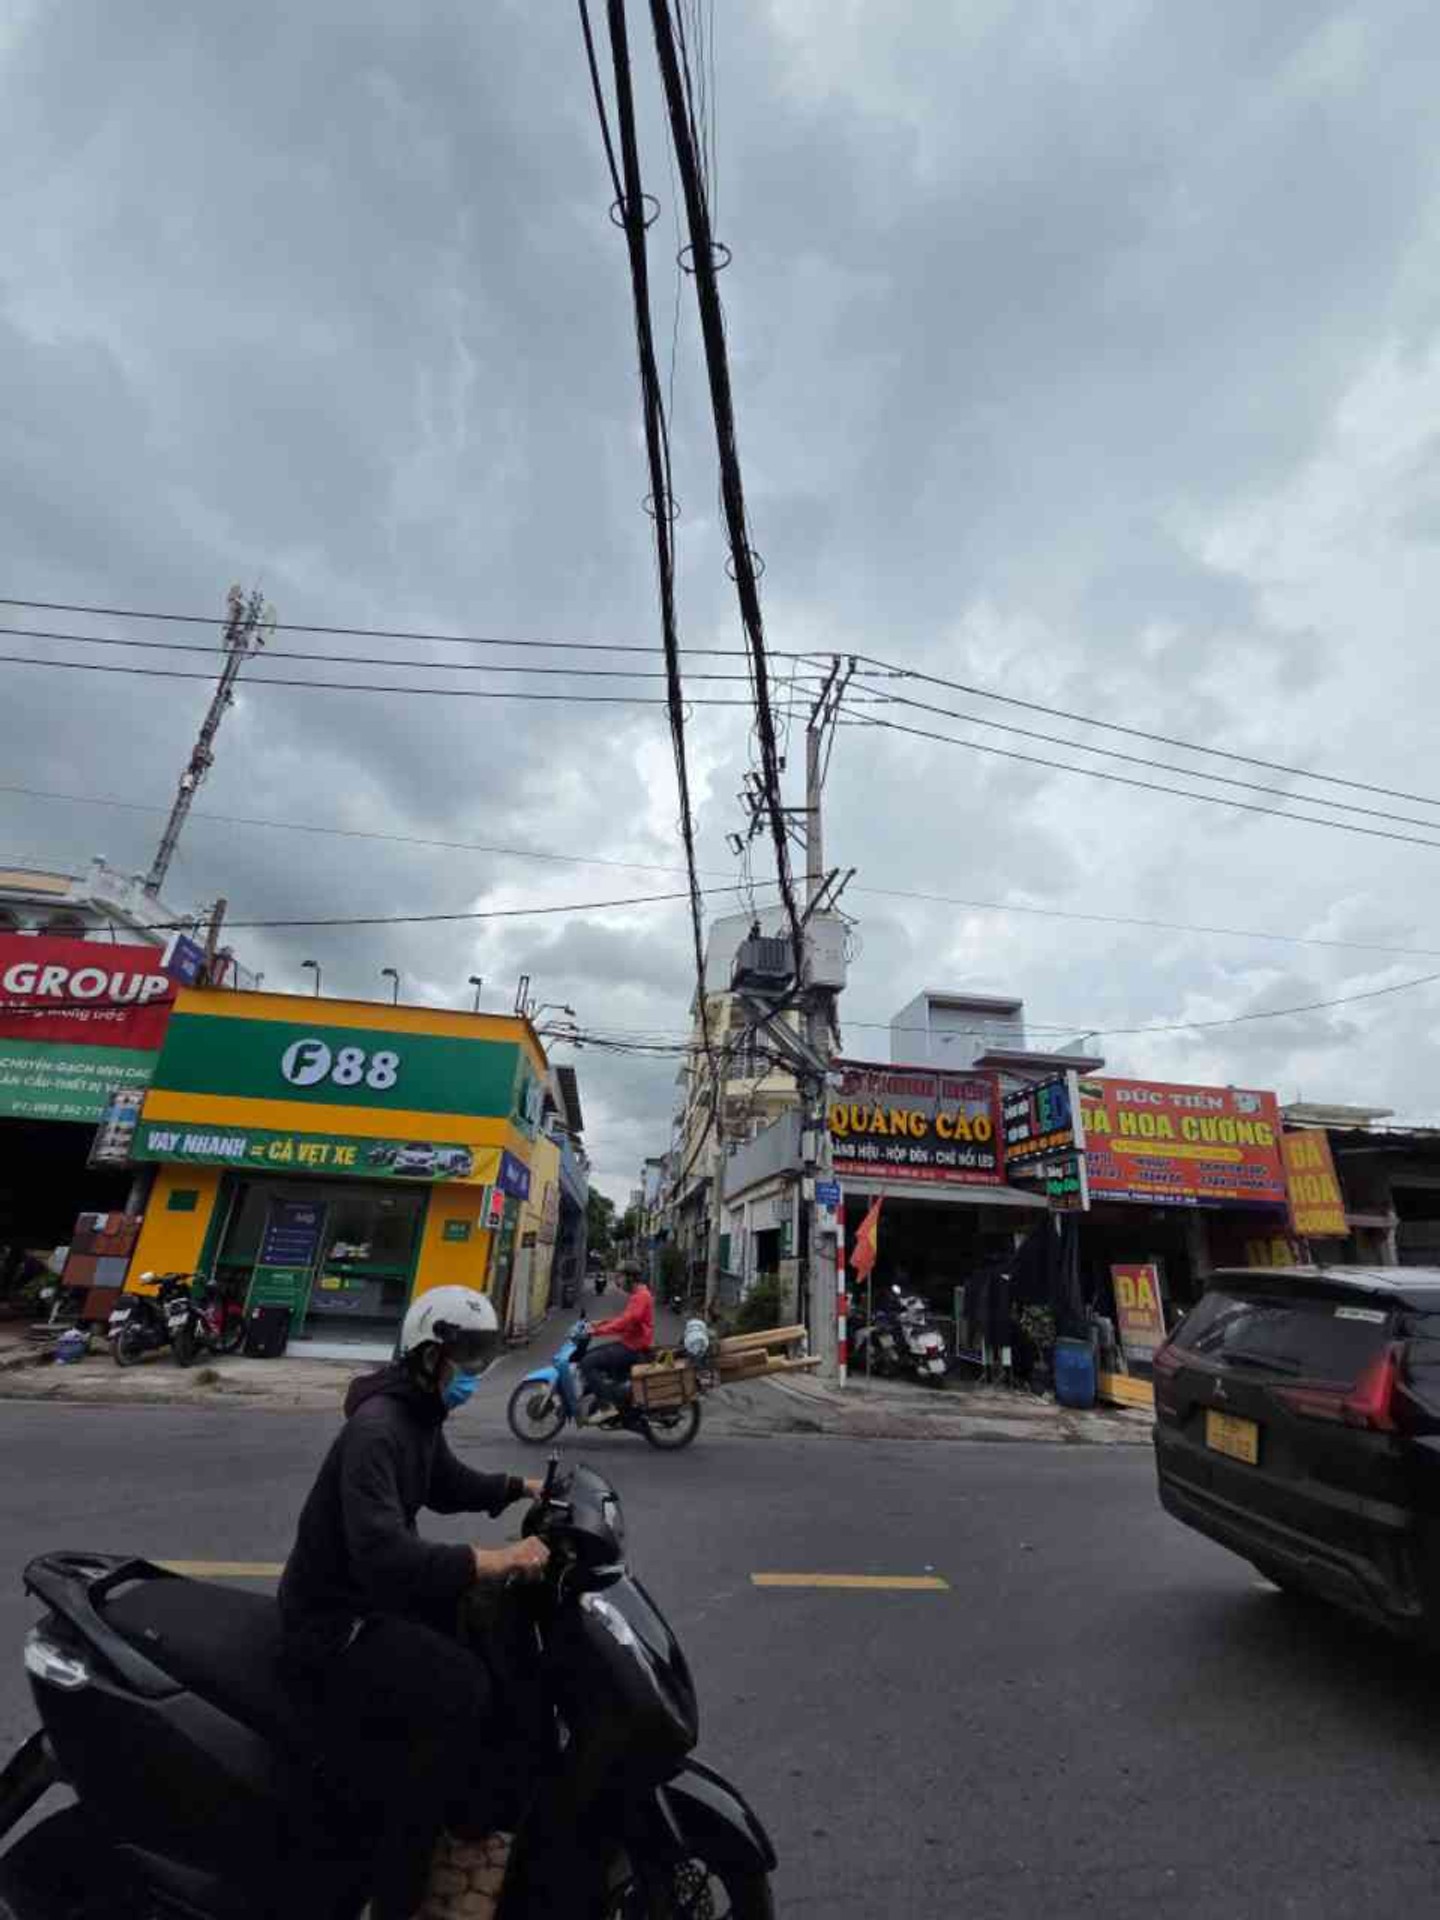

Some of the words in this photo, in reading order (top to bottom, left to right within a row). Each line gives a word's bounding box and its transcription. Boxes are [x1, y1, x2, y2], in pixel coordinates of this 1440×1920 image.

[3, 963, 169, 1004] GROUP
[282, 1038, 399, 1089] F88
[829, 1103, 929, 1138] QUẢNG
[1118, 1111, 1175, 1140] HOA
[147, 1131, 180, 1151] VAY
[182, 1133, 247, 1158] NHANH
[334, 1145, 359, 1166] XE
